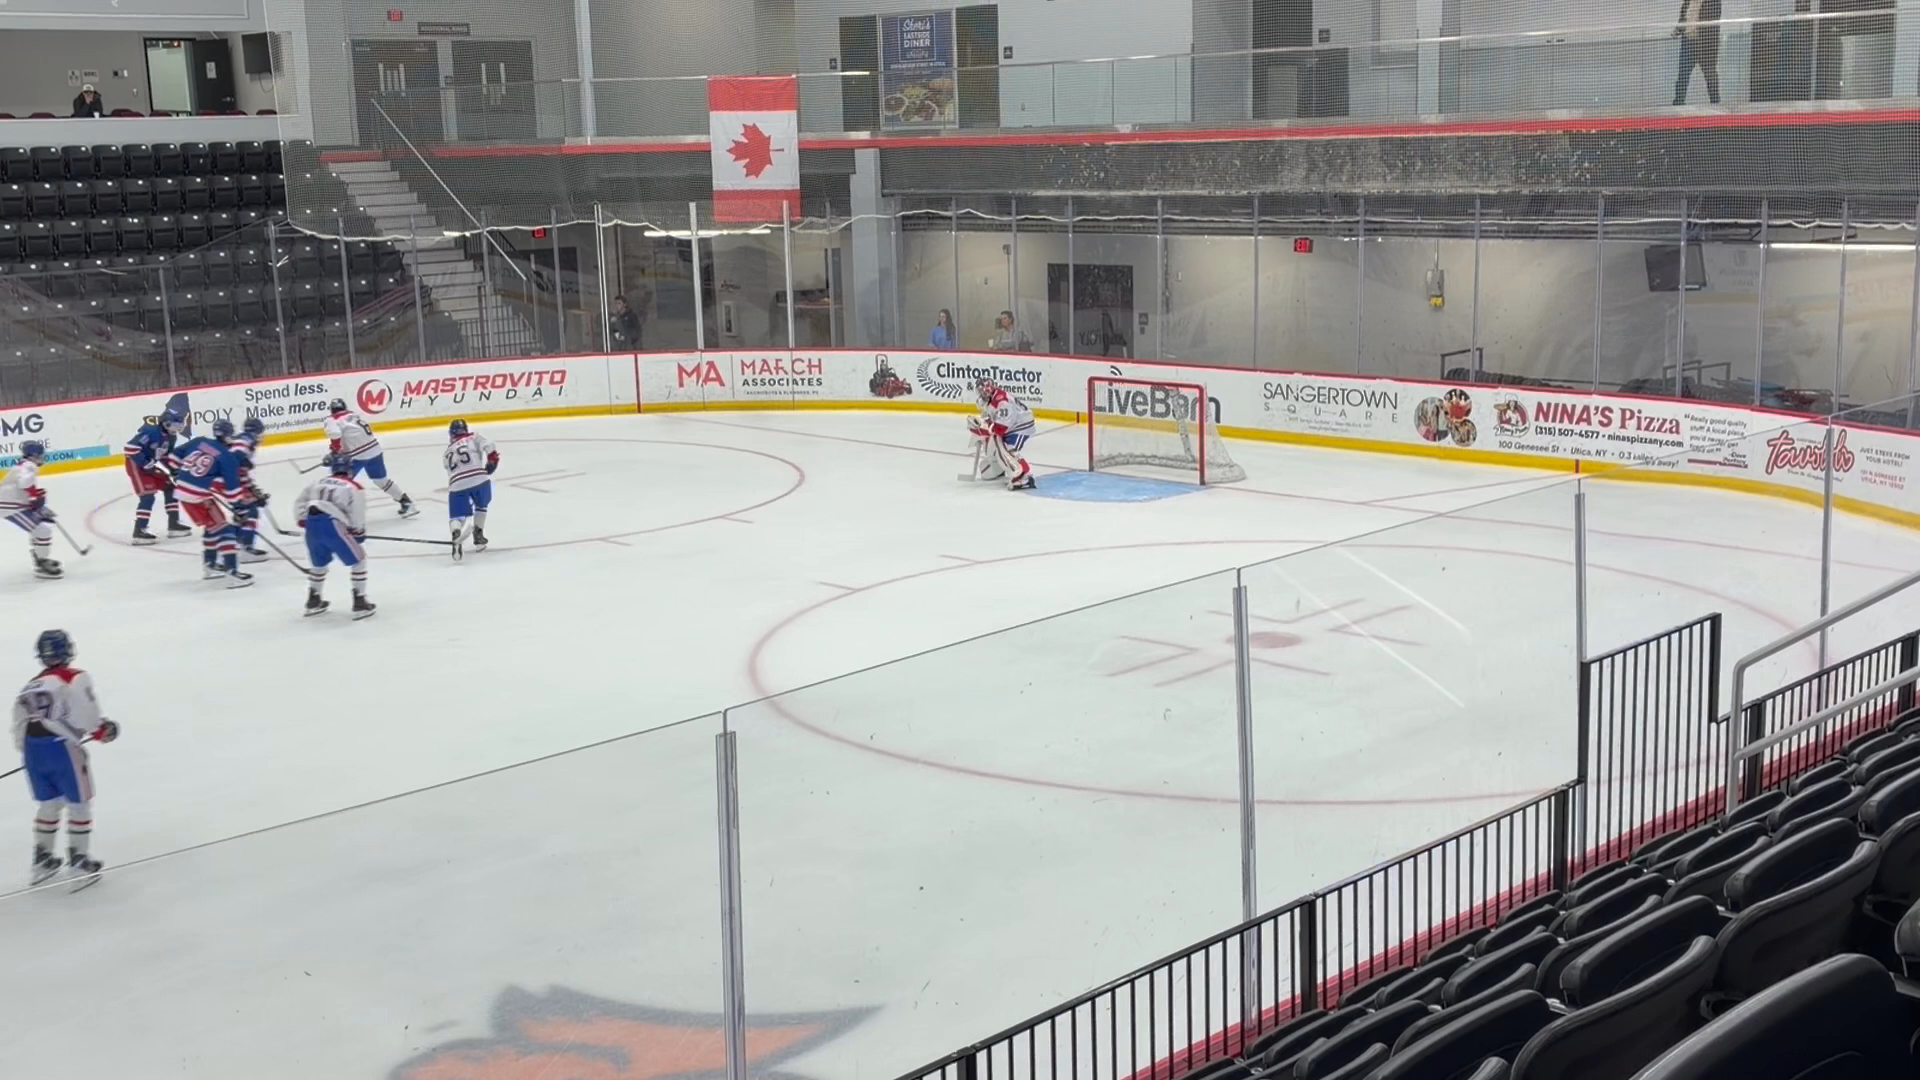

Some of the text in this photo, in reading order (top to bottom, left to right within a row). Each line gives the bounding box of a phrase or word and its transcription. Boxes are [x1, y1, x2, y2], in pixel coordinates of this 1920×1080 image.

[903, 39, 930, 48] DINER
[677, 360, 725, 388] MA
[740, 358, 822, 376] MARCH
[245, 382, 328, 403] Spend less.
[402, 369, 567, 397] MASTROVITO
[742, 378, 823, 387] ASSOCIATES
[966, 382, 973, 391] &
[1029, 384, 1043, 396] Co.
[400, 385, 564, 409] HYUNDAI
[1263, 382, 1398, 410] SANGERTOWN
[194, 407, 233, 425] POLY
[246, 400, 331, 418] Make more.
[1264, 401, 1398, 424] SQUARE
[1534, 401, 1681, 435] NINA'S Pizza
[0, 413, 44, 437] MG
[1535, 425, 1557, 437] (315)
[1558, 427, 1600, 440] 507-4577
[1607, 432, 1684, 448] ninaspizzany.com
[445, 444, 471, 471] 25
[1499, 441, 1513, 450] 100
[1514, 442, 1549, 452] Genesee
[1551, 445, 1560, 454] St
[1570, 447, 1593, 457] Utica,
[1595, 449, 1608, 457] NY
